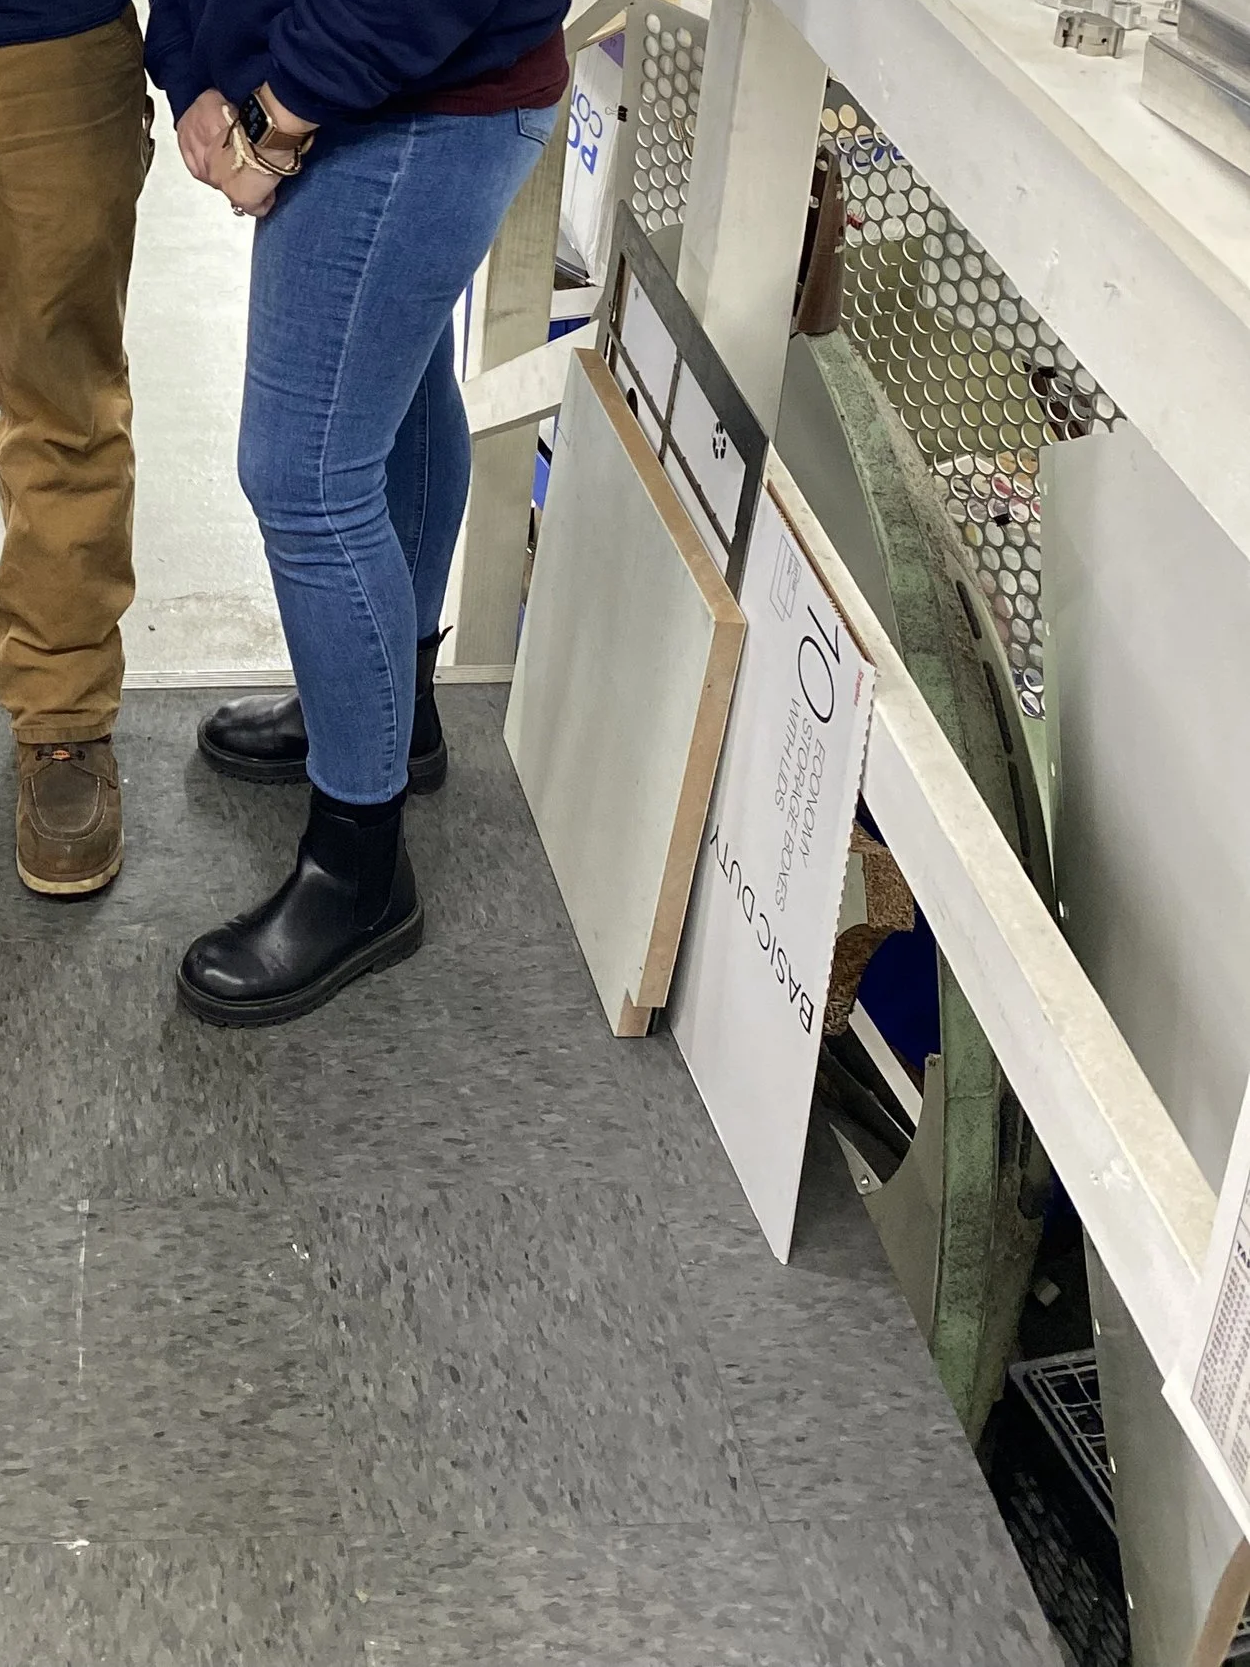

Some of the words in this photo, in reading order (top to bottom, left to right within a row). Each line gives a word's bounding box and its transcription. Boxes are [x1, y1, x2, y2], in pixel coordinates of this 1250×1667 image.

[798, 604, 840, 723] 10
[783, 698, 801, 760] WITH
[787, 718, 813, 836] STORAGE
[775, 756, 791, 812] LIDS
[800, 738, 826, 869] ECONOMY
[710, 824, 755, 924] DUTY
[775, 829, 795, 913] BOXES
[757, 912, 815, 1035] BASIC
